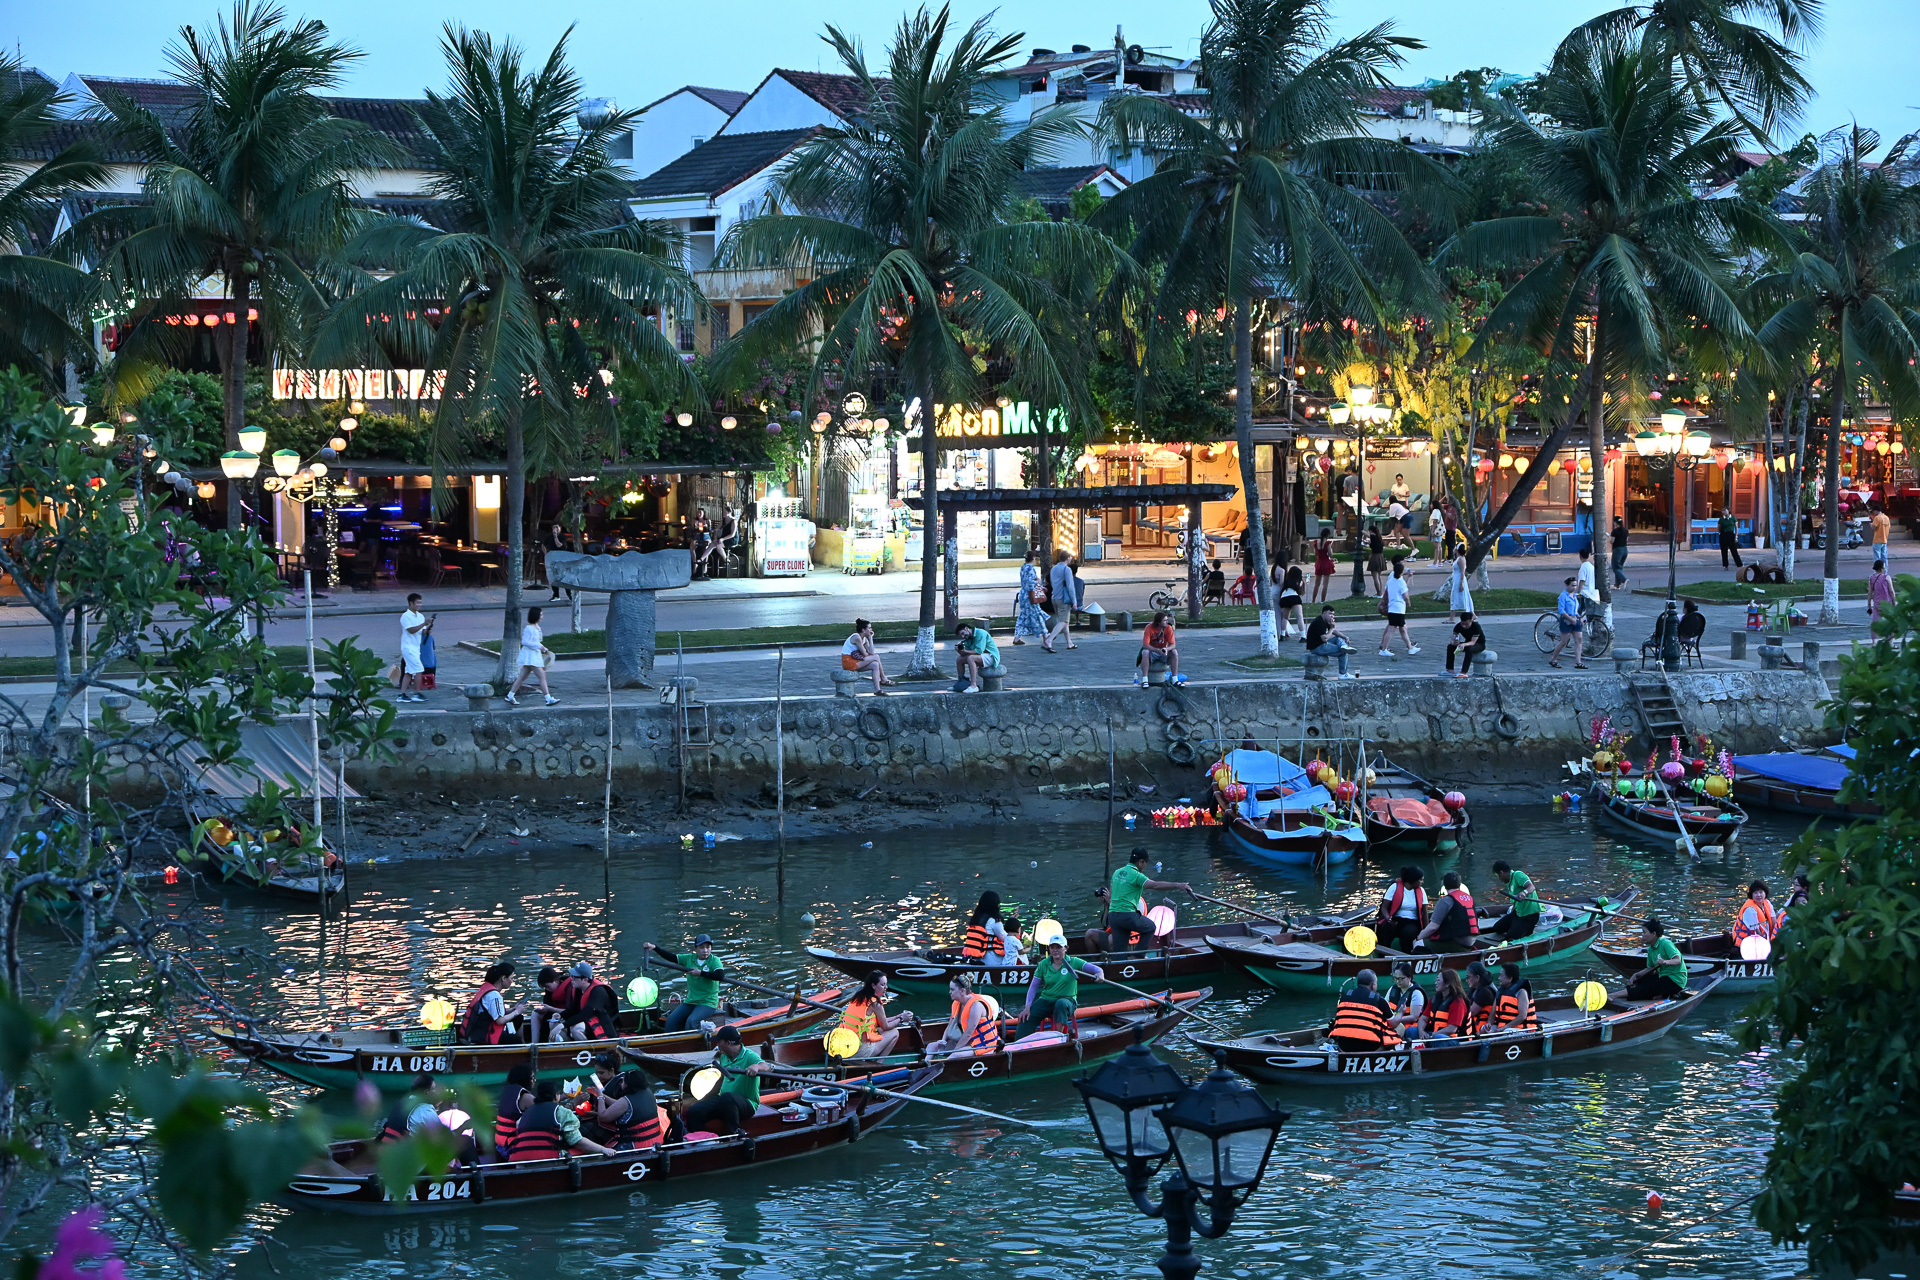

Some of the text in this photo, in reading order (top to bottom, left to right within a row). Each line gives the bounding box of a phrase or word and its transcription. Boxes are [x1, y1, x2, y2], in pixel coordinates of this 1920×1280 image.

[767, 560, 786, 570] SUPER
[966, 970, 1030, 985] HA 132
[1726, 964, 1747, 978] HA
[371, 1056, 447, 1072] HA 036
[427, 1180, 471, 1201] 204
